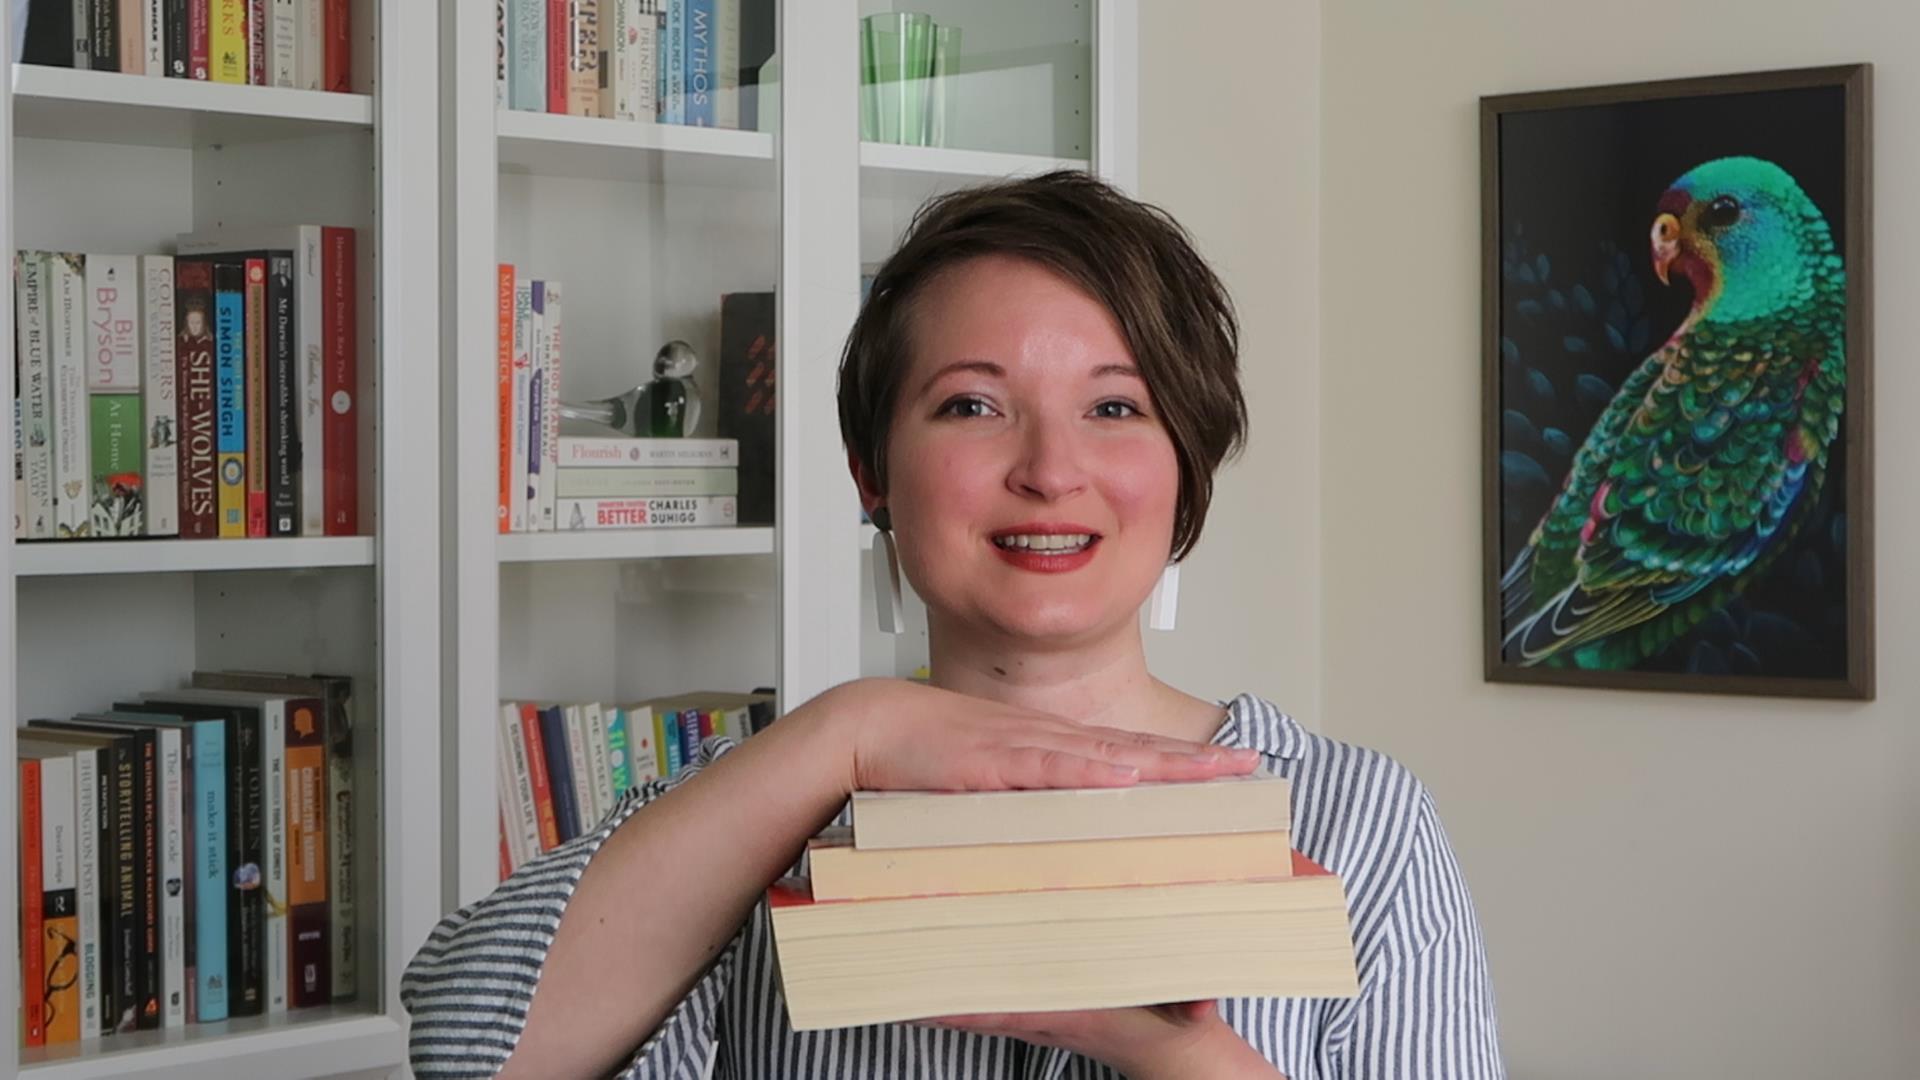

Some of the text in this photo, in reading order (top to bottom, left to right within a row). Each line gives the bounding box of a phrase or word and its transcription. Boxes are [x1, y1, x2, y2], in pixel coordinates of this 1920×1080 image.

[672, 27, 682, 71] HOLMES
[692, 9, 708, 105] MYTHOS
[26, 262, 40, 314] EMPIRE
[278, 297, 288, 313] Mr
[500, 273, 511, 317] MADE
[29, 330, 41, 368] BLUE
[92, 287, 118, 384] Bryson
[115, 320, 134, 356] Bill
[158, 268, 174, 401] COURTIERS
[278, 315, 288, 358] Darwin's
[219, 307, 234, 436] SIMON SINGH
[279, 359, 289, 407] incredible
[499, 340, 512, 384] STICK
[30, 372, 43, 419] WATER
[549, 325, 561, 464] THE $100 STARTUP
[109, 400, 122, 471] At Home
[190, 351, 213, 516] SHE-WOLVES
[278, 409, 289, 456] shrinking
[572, 443, 622, 459] Flourish
[30, 461, 39, 498] TALTY
[40, 451, 49, 508] STEPHAN
[280, 457, 289, 486] world
[597, 508, 648, 525] BETTER
[648, 499, 698, 511] CHARLES
[650, 513, 697, 525] DUHIGG
[167, 751, 178, 776] The
[510, 723, 534, 826] DESIGNING YOUR LIFE
[606, 728, 627, 790] flow
[81, 765, 94, 859] HUFFINGTON
[119, 763, 133, 861] STORYTELLING
[248, 767, 262, 851] TOLKIEN
[167, 830, 179, 865] Code
[206, 791, 219, 879] make it stick
[83, 863, 95, 898] POST
[121, 866, 134, 918] ANIMAL
[85, 943, 95, 999] BLOGGING
